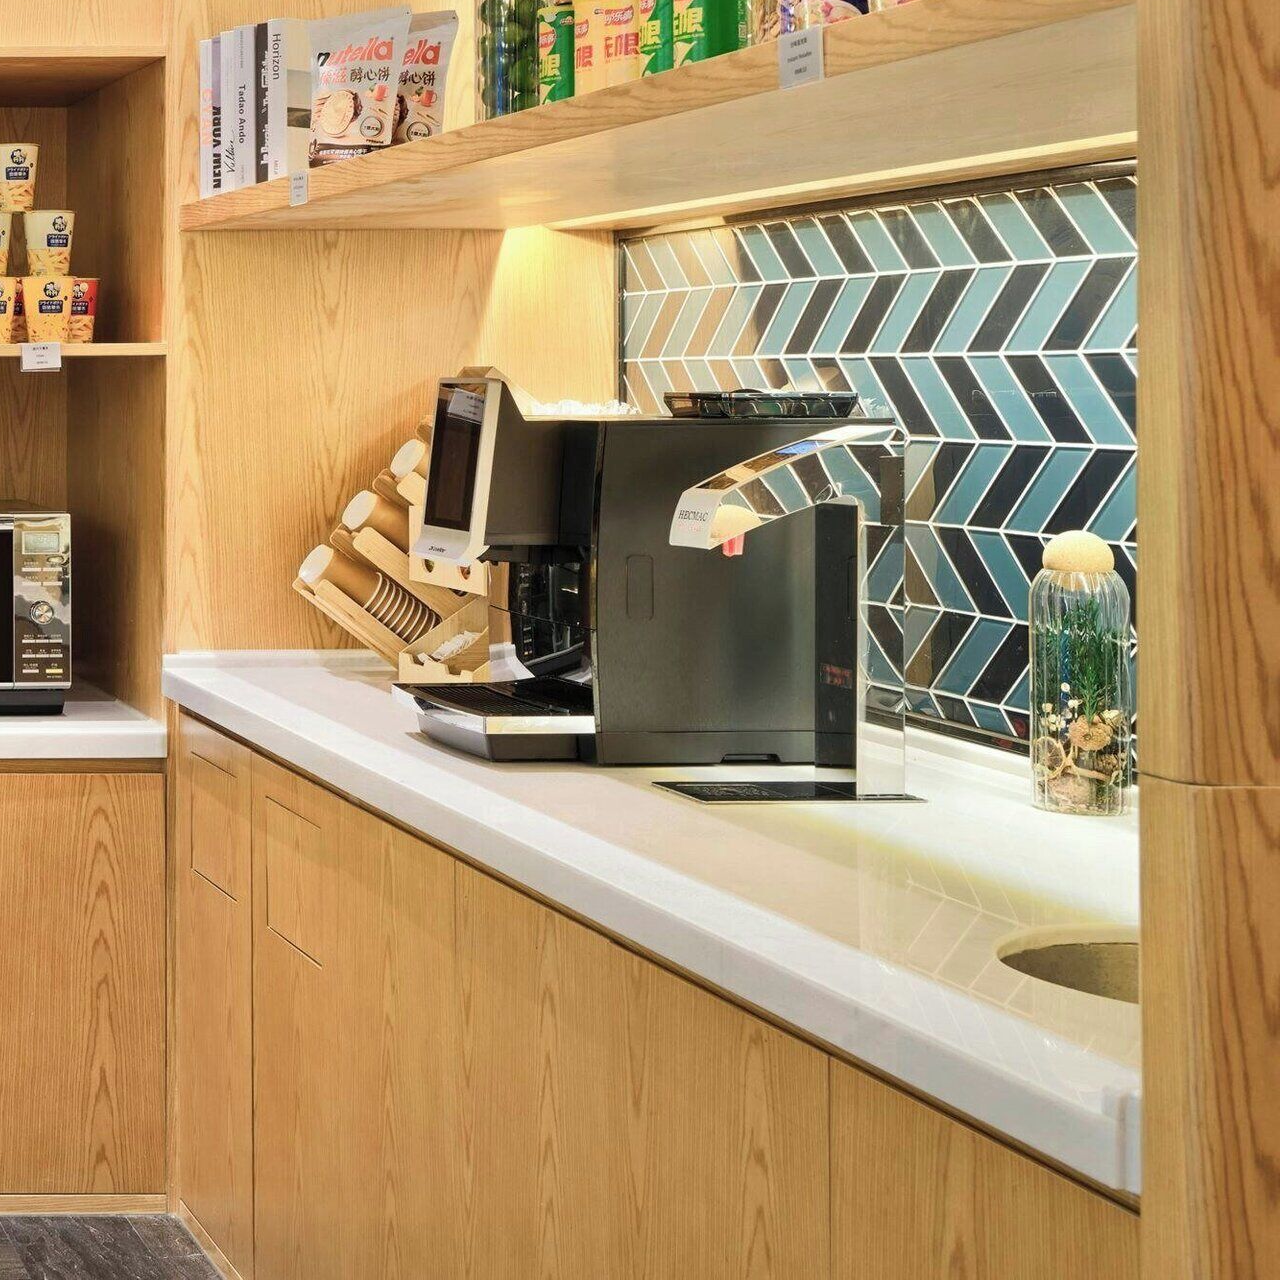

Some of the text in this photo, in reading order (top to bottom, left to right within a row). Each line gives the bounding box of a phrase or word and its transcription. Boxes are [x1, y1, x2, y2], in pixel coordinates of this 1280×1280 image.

[271, 33, 281, 80] Horizon
[317, 36, 393, 67] nutella
[238, 84, 246, 144] Tadao Ando
